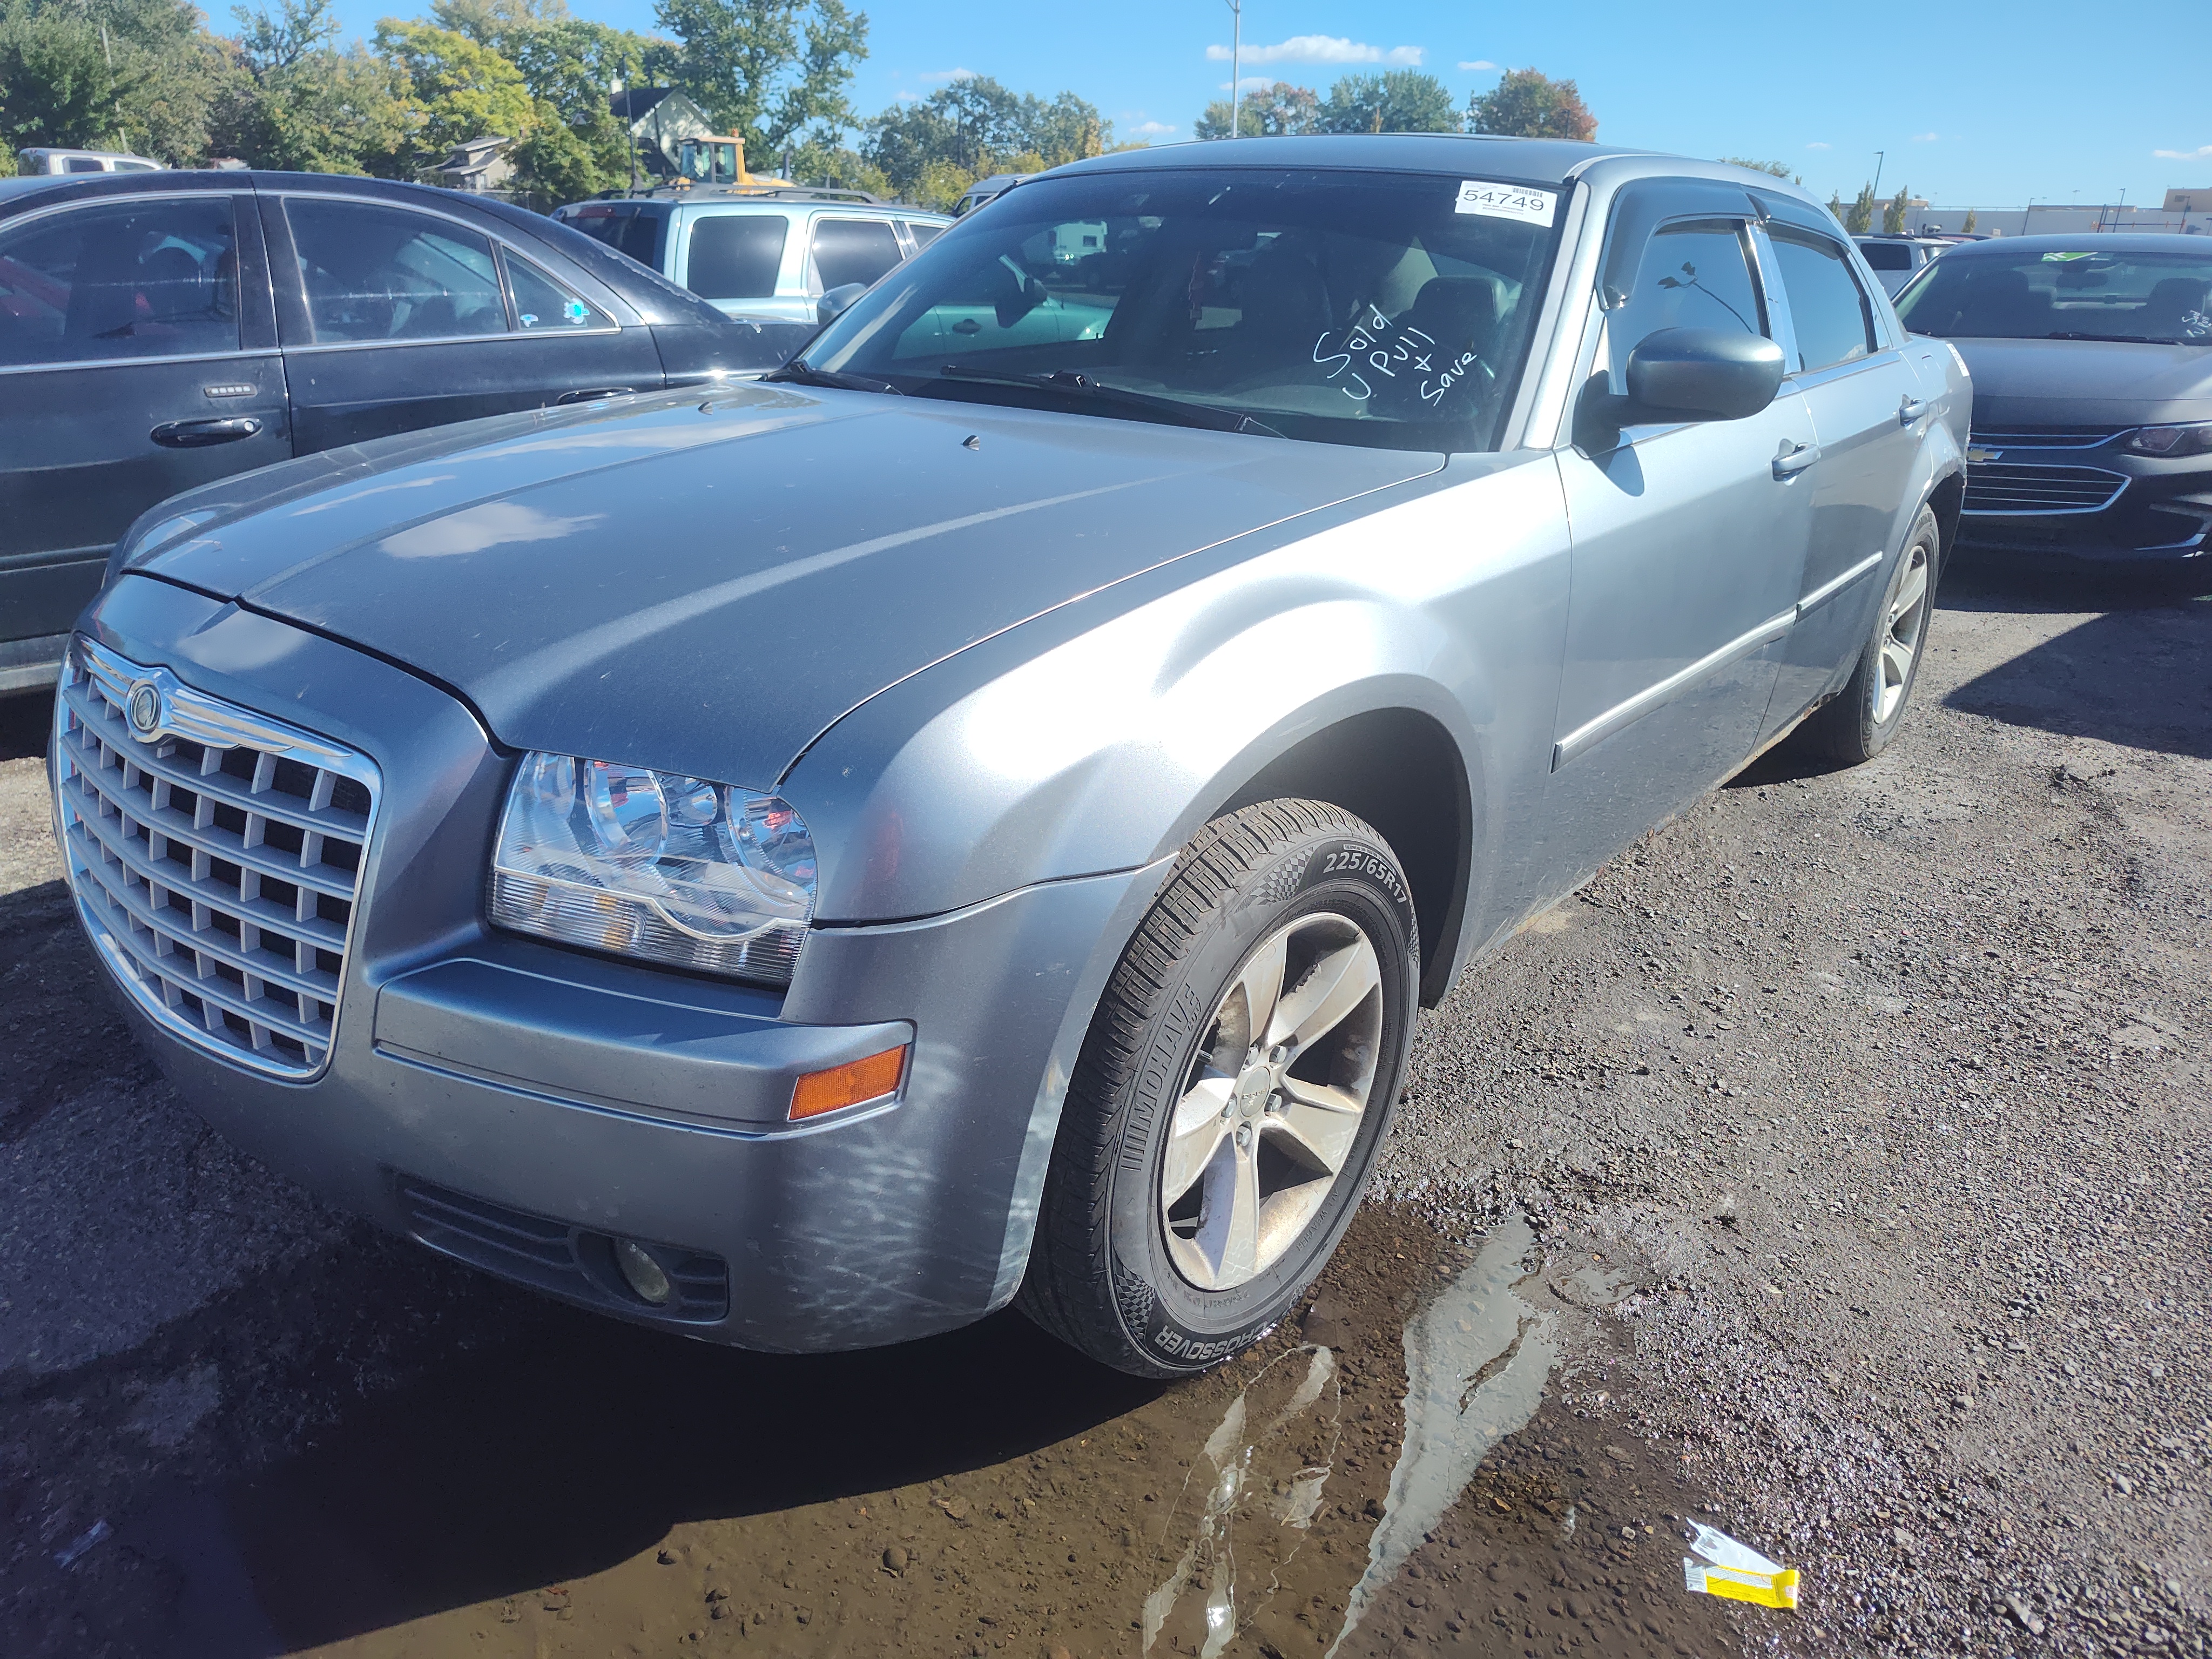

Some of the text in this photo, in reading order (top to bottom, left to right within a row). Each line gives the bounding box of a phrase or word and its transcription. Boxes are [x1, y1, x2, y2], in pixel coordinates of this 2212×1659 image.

[1463, 190, 1544, 211] 54749
[1313, 304, 1394, 379] Sold
[1342, 373, 1372, 400] U
[1420, 352, 1478, 407] Save
[1323, 851, 1407, 903] 225/65R17
[1133, 981, 1199, 1125] MOHAVE
[1296, 1210, 1328, 1251] WEATHER
